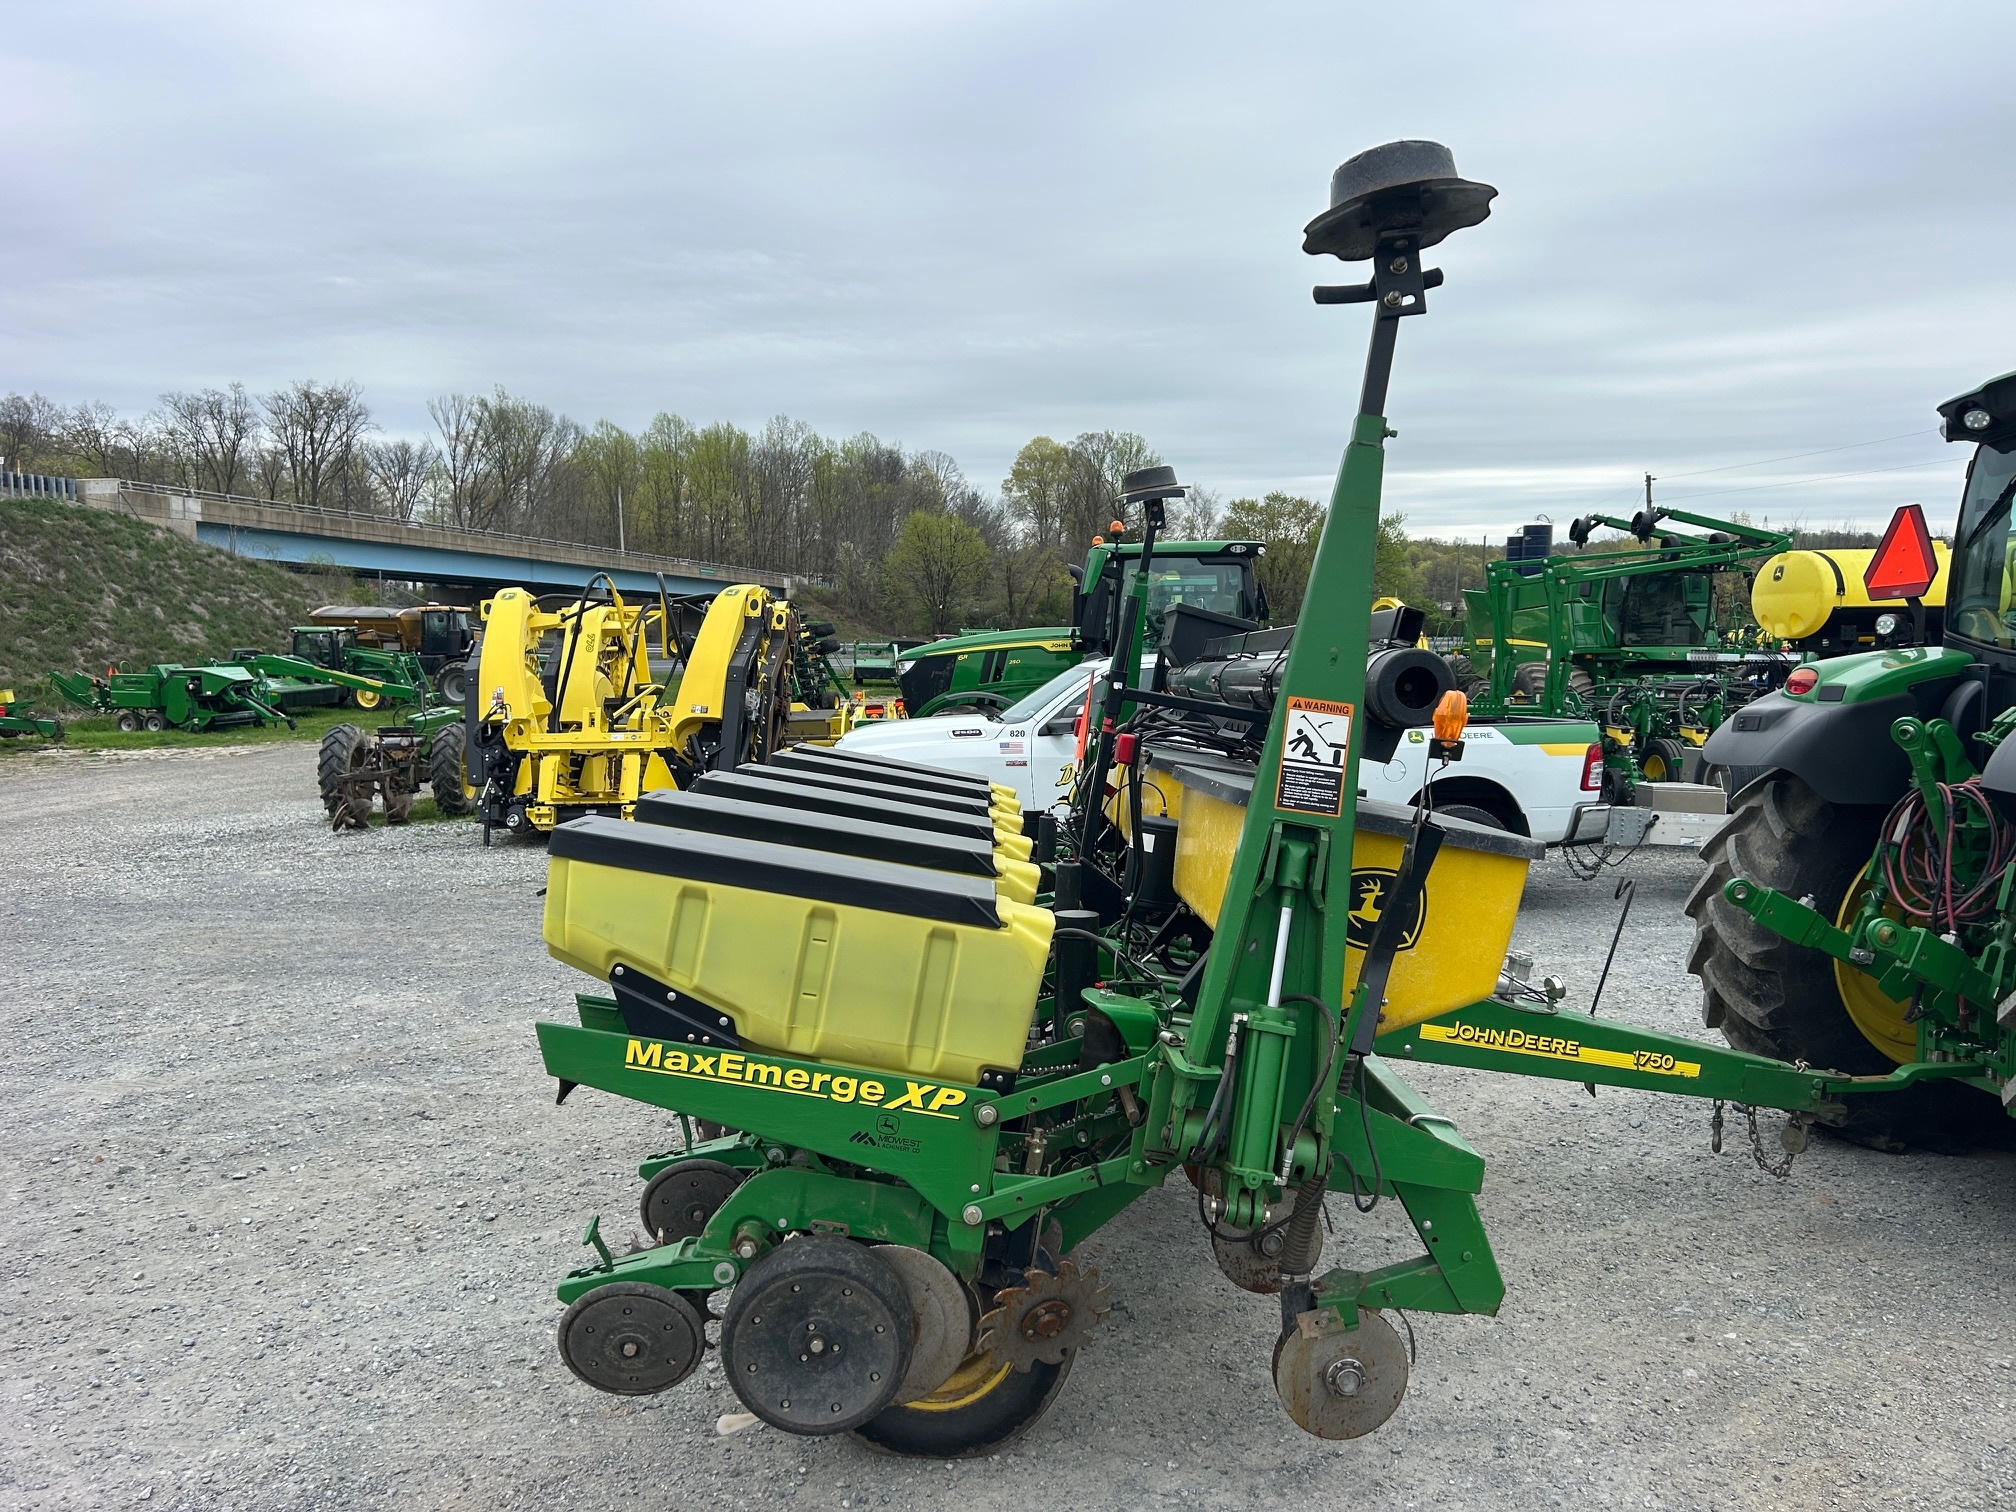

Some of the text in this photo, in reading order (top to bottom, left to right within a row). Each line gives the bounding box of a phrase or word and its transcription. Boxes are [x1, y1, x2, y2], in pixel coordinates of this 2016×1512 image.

[586, 634, 595, 652] 770
[1304, 701, 1350, 715] WARNING
[1009, 730, 1026, 738] 820
[1445, 1020, 1675, 1071] JOHN DEERE 1750
[624, 1038, 967, 1112] MaxEmerge XP
[878, 1134, 922, 1148] MIDWEST
